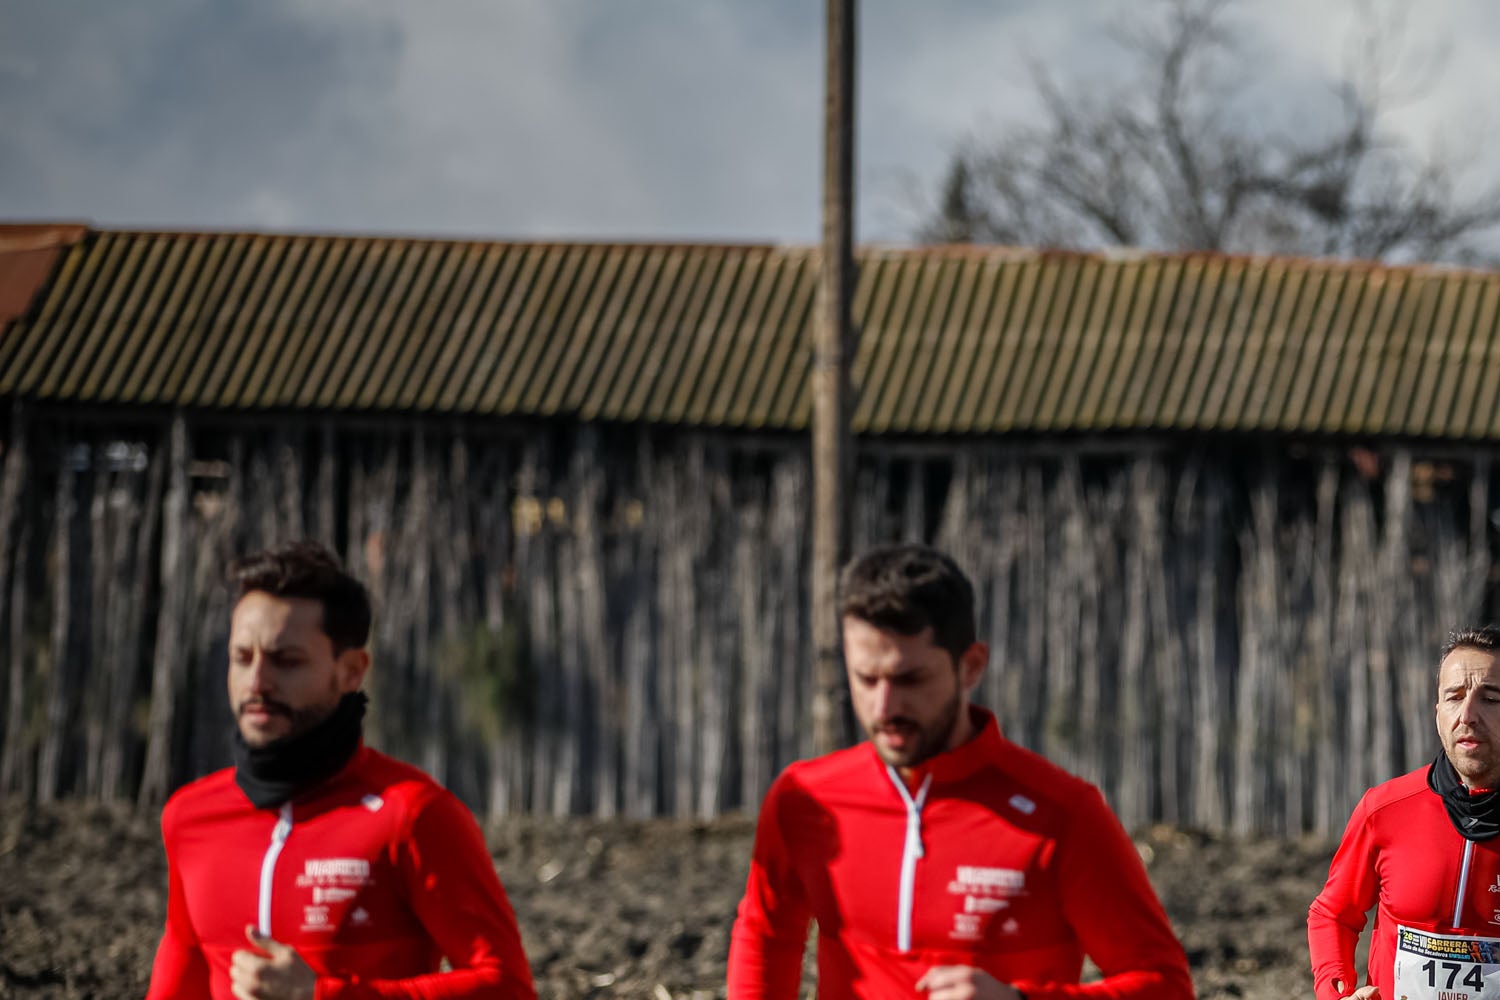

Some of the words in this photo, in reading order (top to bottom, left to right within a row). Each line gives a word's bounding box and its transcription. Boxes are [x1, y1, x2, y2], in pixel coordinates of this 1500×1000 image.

[1427, 937, 1468, 949] CARRERA
[1427, 944, 1468, 954] POPULAR
[1422, 959, 1484, 993] 174
